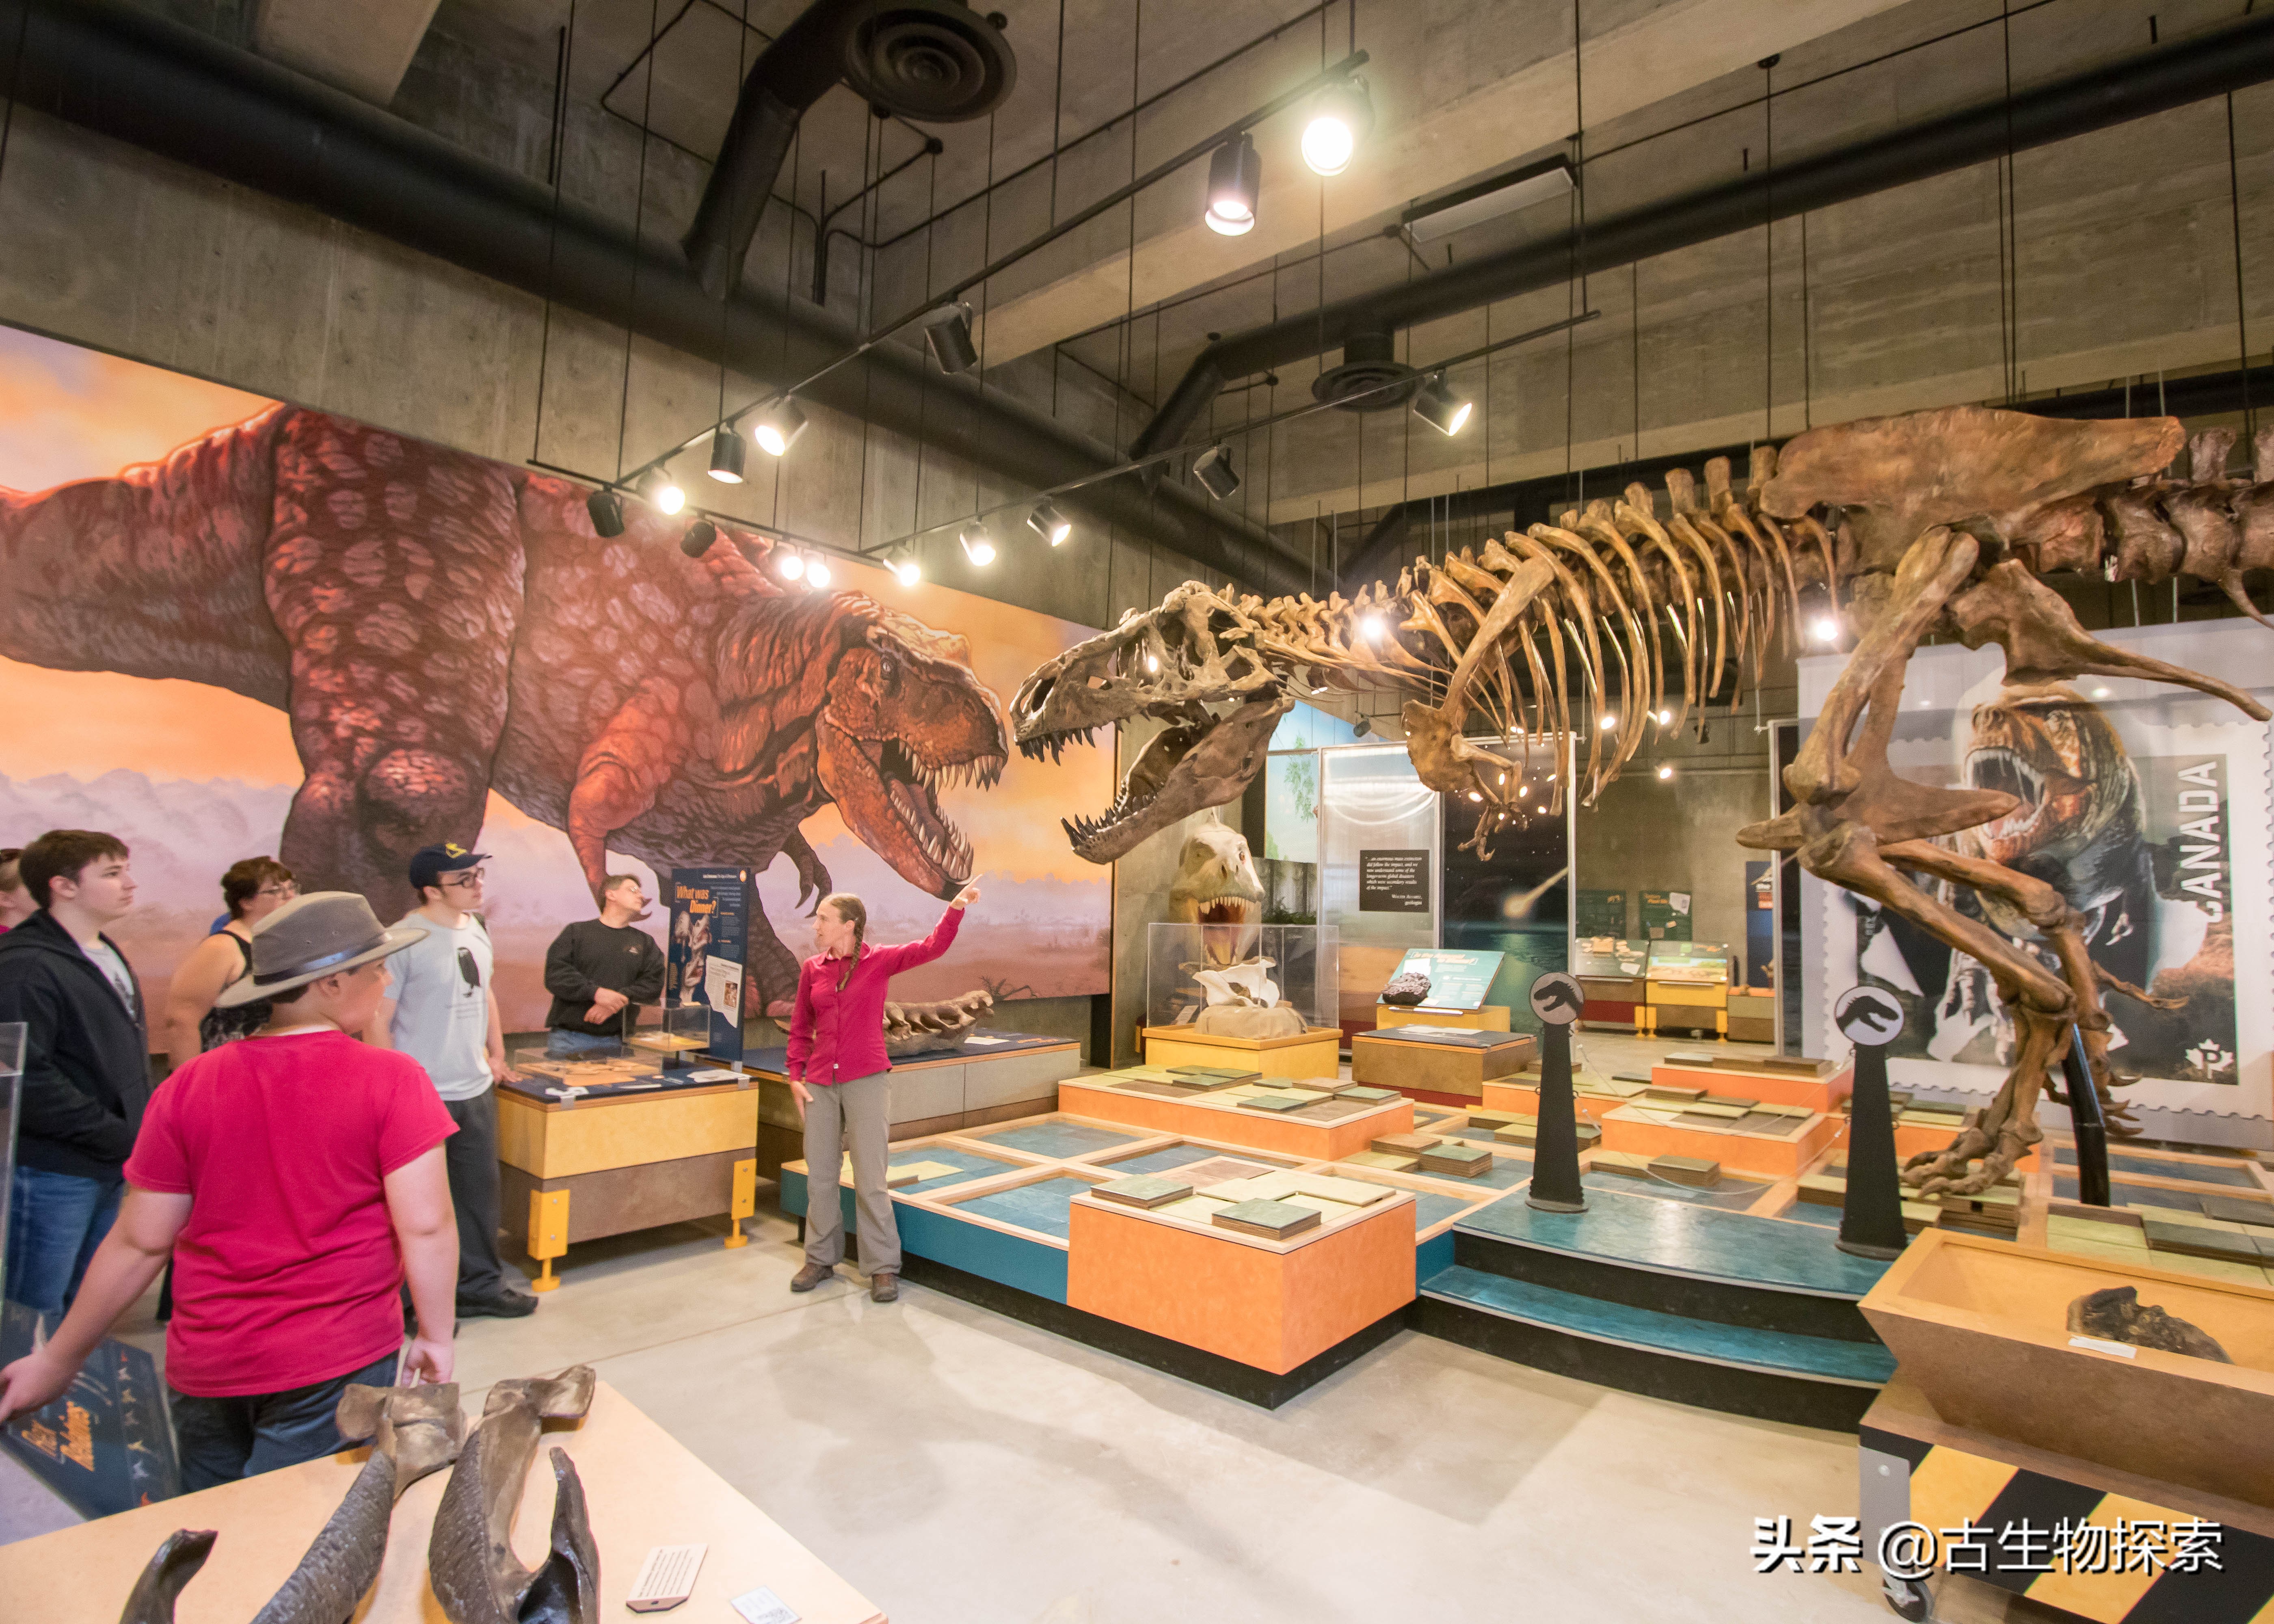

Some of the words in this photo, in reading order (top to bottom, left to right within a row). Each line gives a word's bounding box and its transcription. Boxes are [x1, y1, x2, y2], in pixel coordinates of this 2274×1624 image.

[677, 885, 695, 900] What
[695, 890, 709, 900] was
[690, 900, 716, 914] Dinner?
